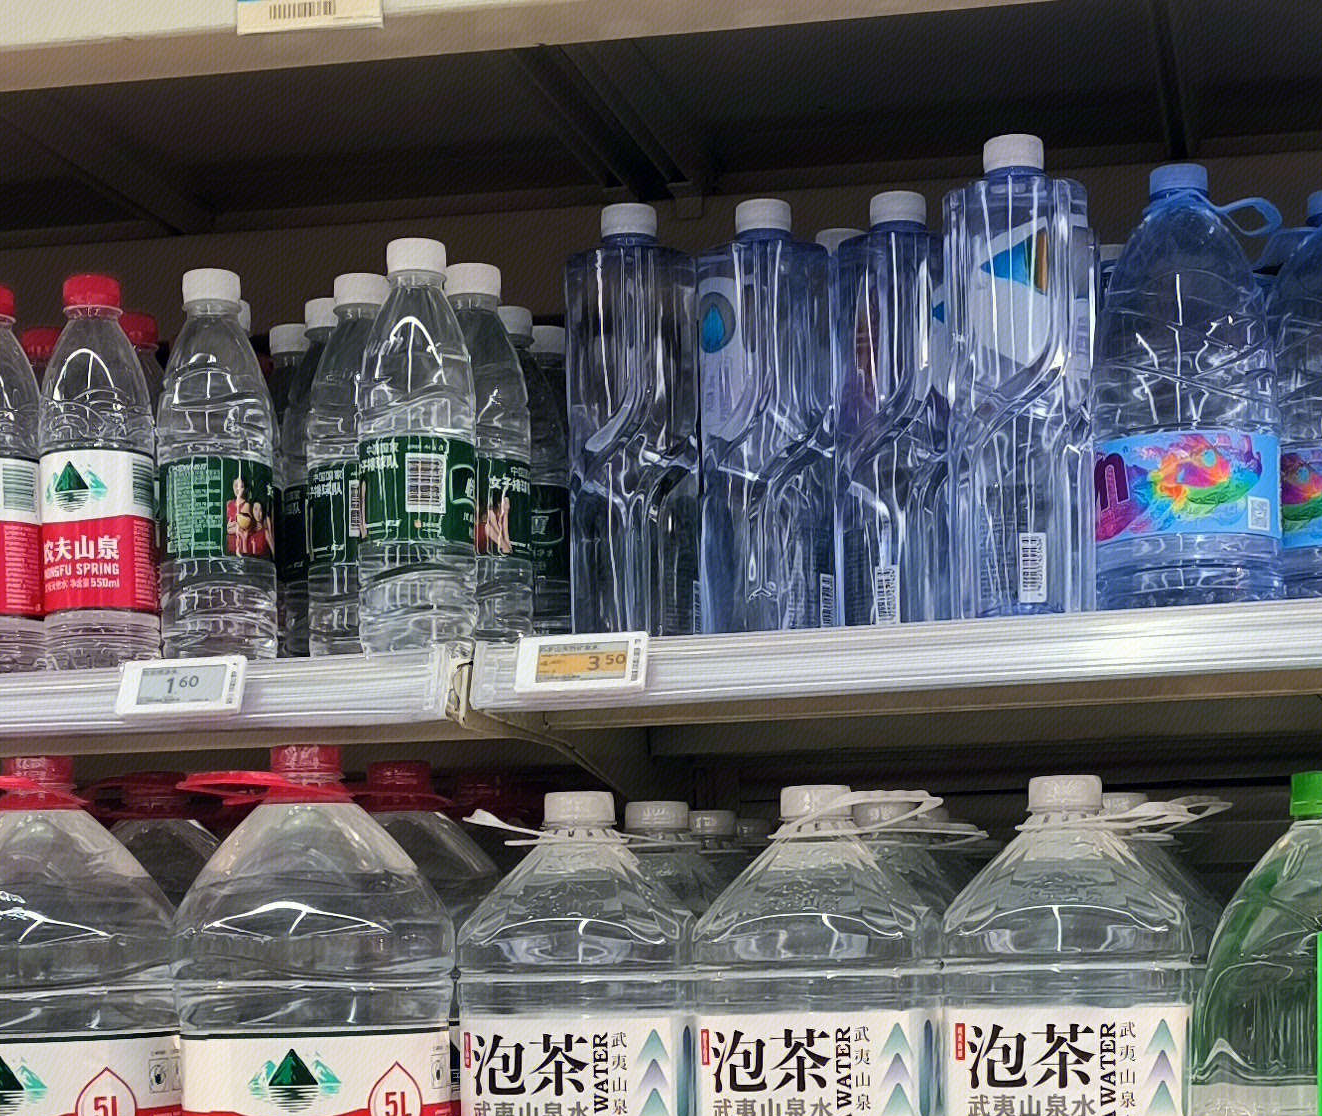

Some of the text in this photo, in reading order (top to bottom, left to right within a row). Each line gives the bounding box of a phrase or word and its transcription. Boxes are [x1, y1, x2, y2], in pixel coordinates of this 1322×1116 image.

[44, 535, 120, 562] 农夫山泉
[76, 562, 120, 577] SPRING
[472, 1033, 589, 1097] 泡茶
[593, 1032, 609, 1114] WATER
[711, 1029, 831, 1093] 泡茶
[835, 1026, 852, 1105] WATER
[967, 1023, 1095, 1089] 泡茶
[1099, 1022, 1116, 1102] WATER
